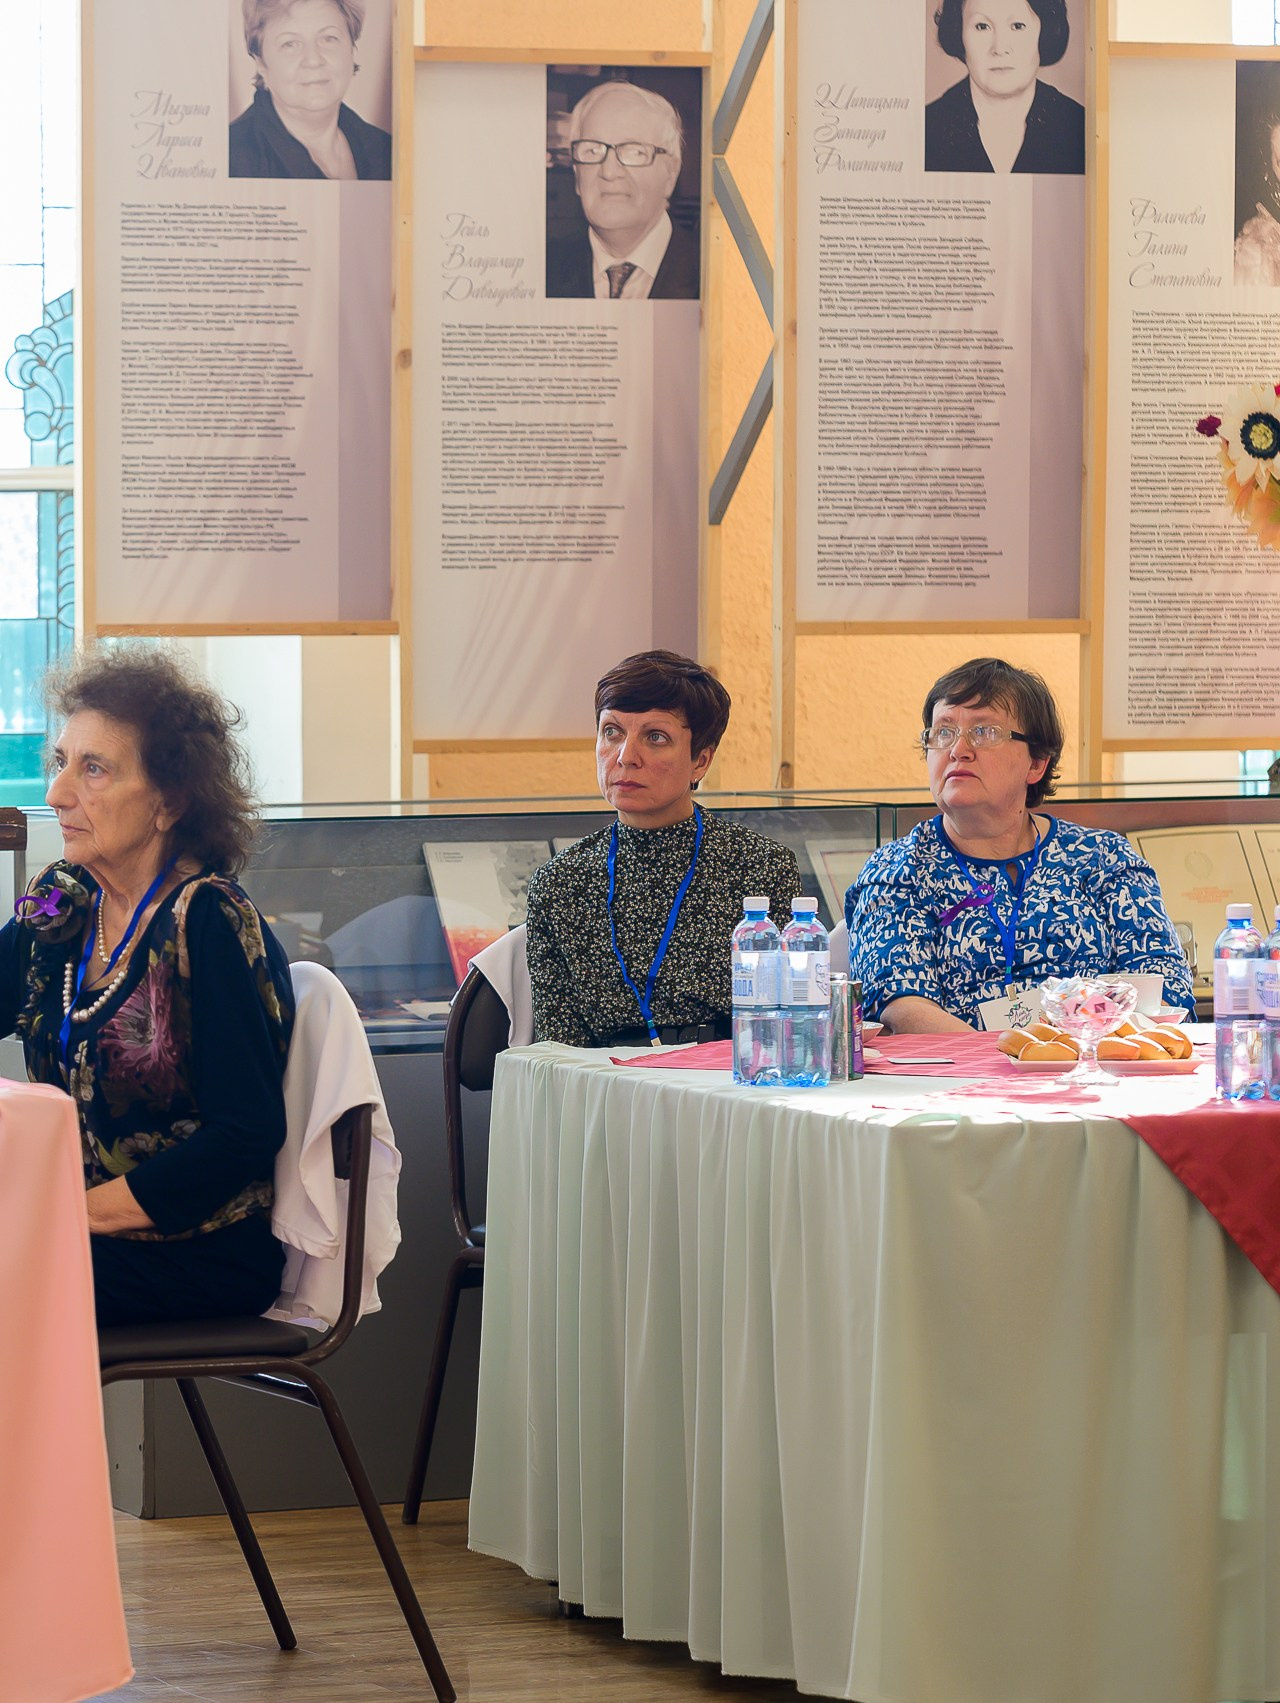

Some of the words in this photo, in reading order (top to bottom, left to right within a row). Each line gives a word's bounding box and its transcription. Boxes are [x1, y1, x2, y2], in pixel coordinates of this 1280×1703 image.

[131, 121, 204, 157] Лариса
[1127, 230, 1188, 257] Галина
[1129, 262, 1223, 288] Степановна
